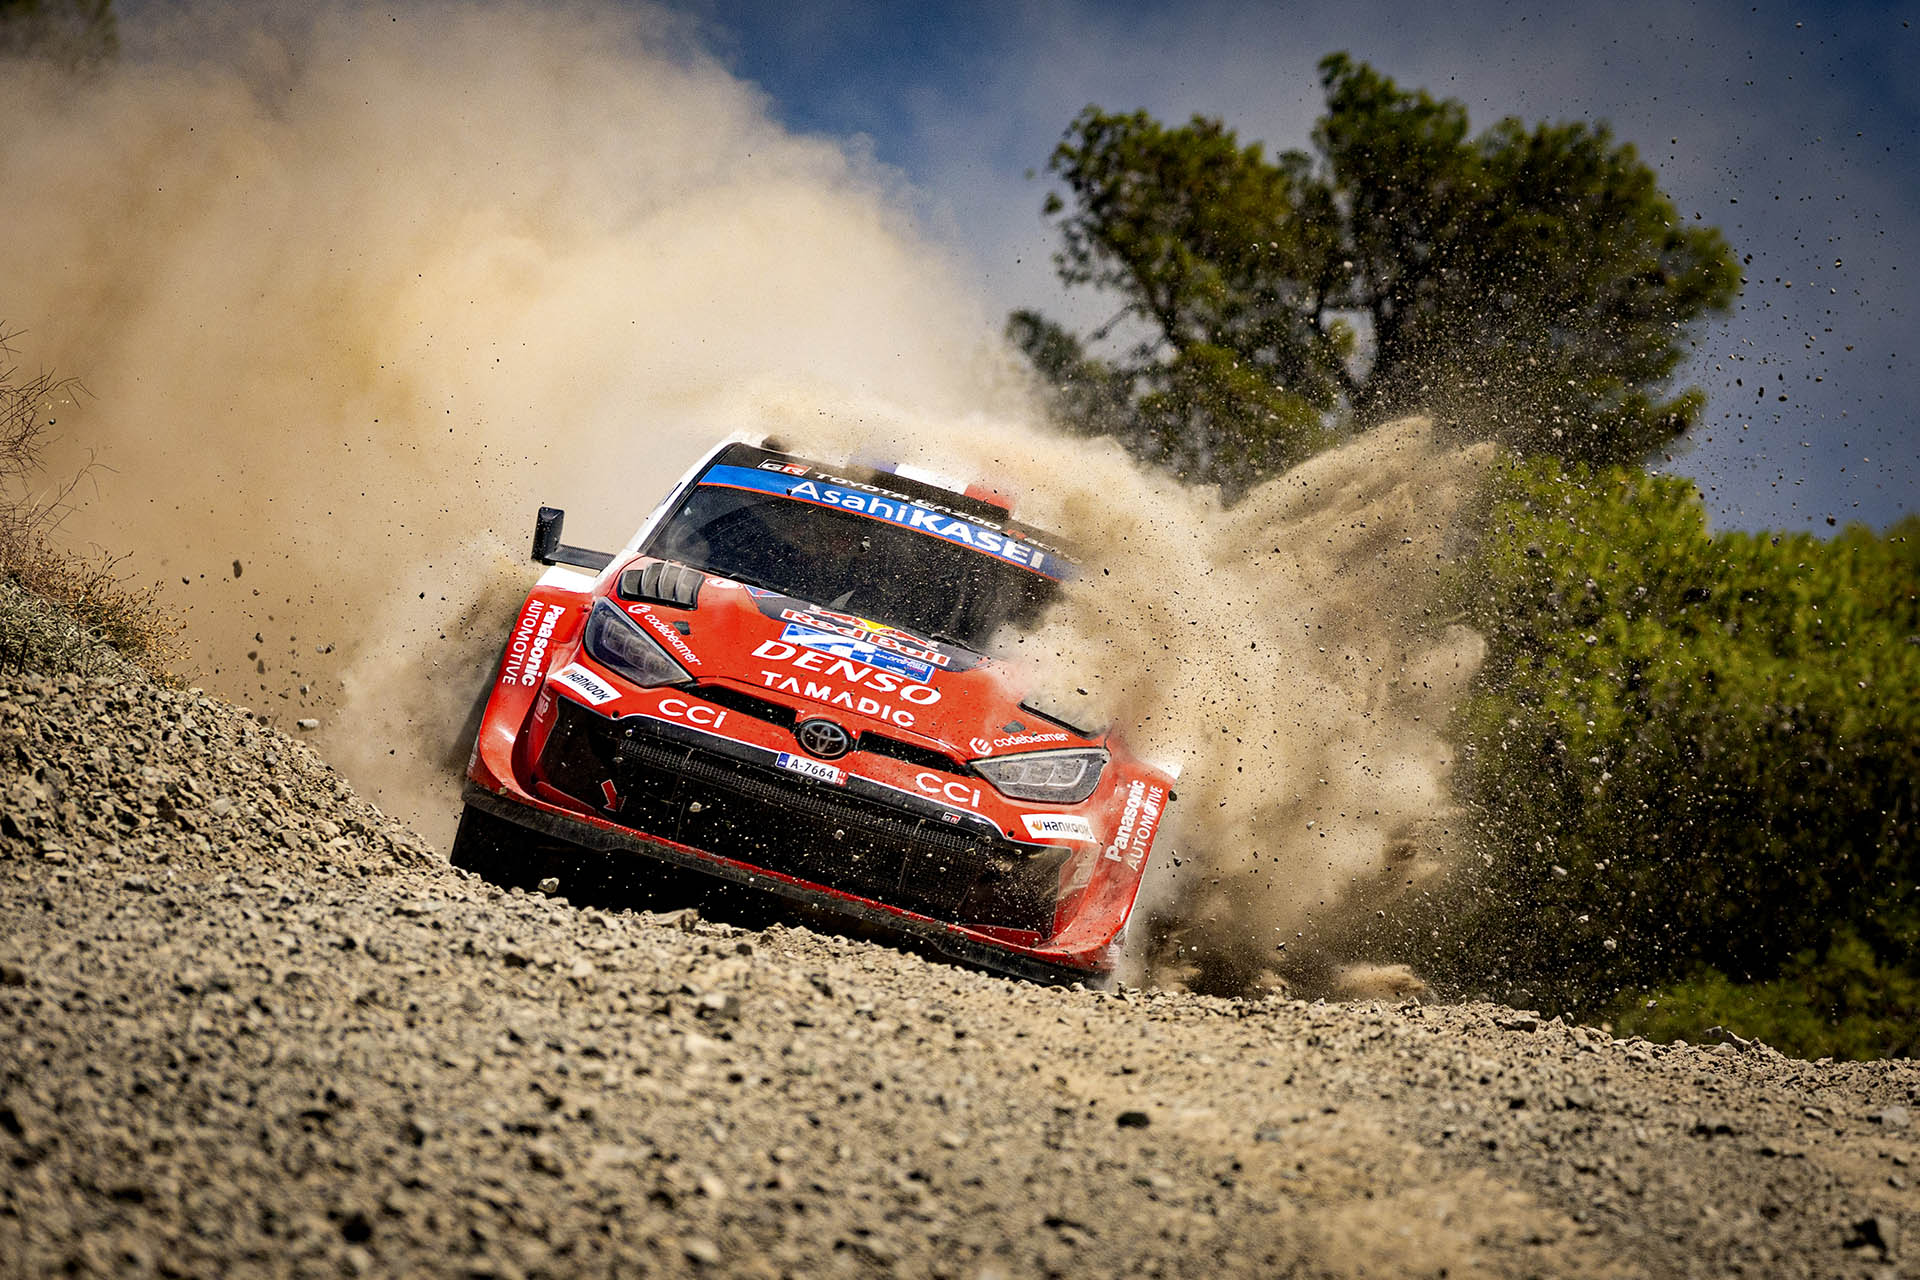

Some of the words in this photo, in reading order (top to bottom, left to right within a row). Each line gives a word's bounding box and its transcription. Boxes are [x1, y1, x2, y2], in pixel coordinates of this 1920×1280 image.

[758, 461, 805, 476] GR
[815, 472, 910, 501] TOYOTA
[909, 499, 1002, 530] GAZOO
[502, 600, 545, 686] AUTOMOTIVE
[521, 604, 566, 687] Panasonic
[644, 614, 700, 664] codebeamer
[780, 608, 866, 642] Red
[865, 632, 951, 667] Bull
[751, 639, 942, 705] DENSO
[760, 670, 916, 727] TAMADIC
[658, 698, 728, 729] CCI
[993, 732, 1069, 748] codebeamer
[790, 758, 834, 780] A-7664
[915, 772, 981, 808] CCI
[1104, 779, 1146, 863] Panasonic
[1126, 785, 1164, 872] AUTOMOTIVE
